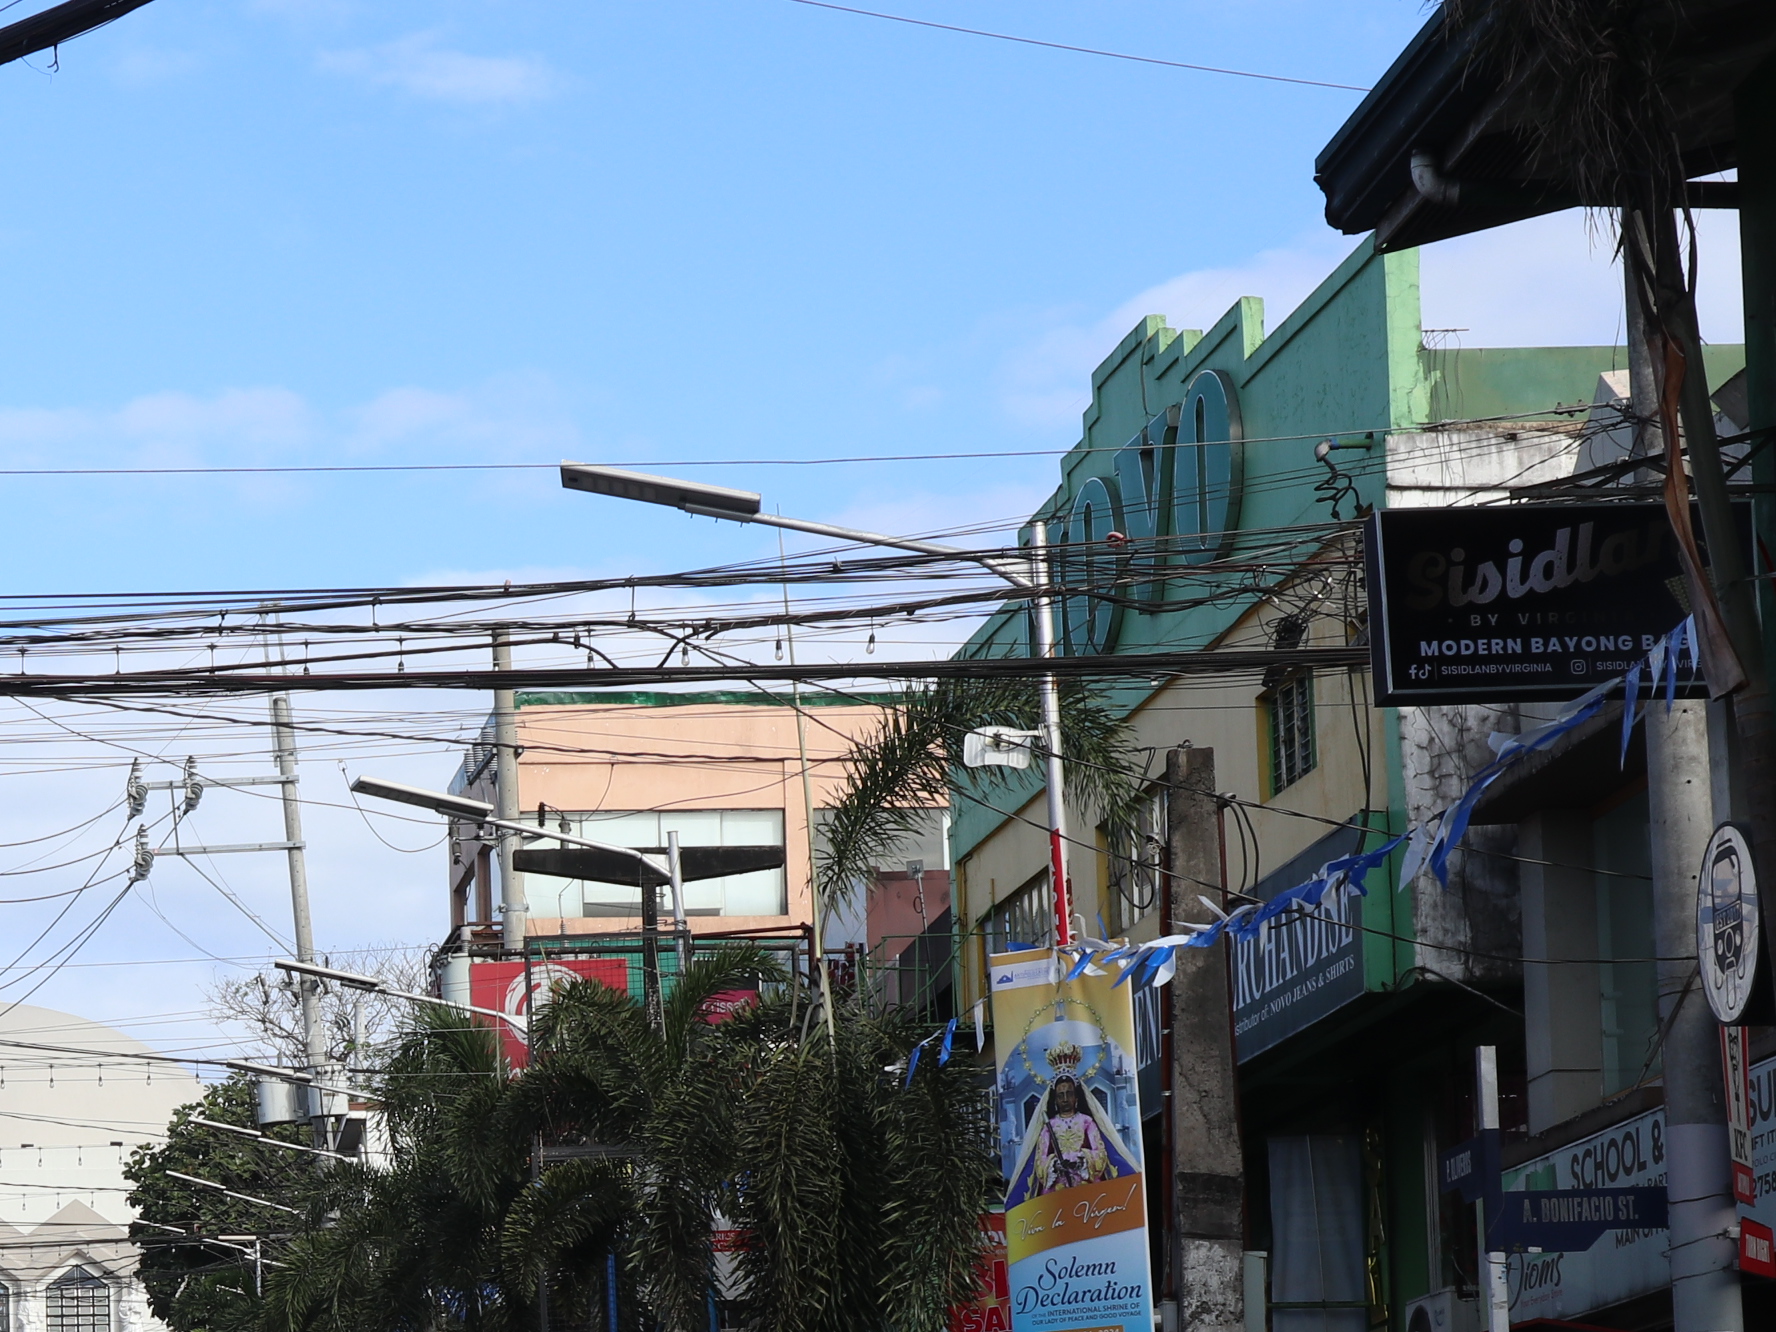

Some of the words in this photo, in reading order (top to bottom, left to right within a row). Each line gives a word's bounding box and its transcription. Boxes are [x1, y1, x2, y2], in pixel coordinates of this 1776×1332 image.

[1471, 614, 1499, 626] BY
[1420, 637, 1523, 657] MODERN
[1530, 635, 1633, 653] BAYONG
[1441, 662, 1553, 675] SISIDLANBYVIRGINIA
[1270, 996, 1291, 1018] NOVO
[1292, 982, 1316, 1004] JEANS
[1325, 954, 1354, 982] SHIRTS
[1571, 1127, 1647, 1190] SCHOOL
[1652, 1119, 1664, 1165] &
[1734, 1127, 1749, 1163] KFC
[1014, 1211, 1045, 1239] Viva
[1052, 1208, 1065, 1228] la
[1073, 1183, 1137, 1229] Virgen!
[1523, 1199, 1537, 1224] A.
[1541, 1196, 1614, 1222] BONIFACIO
[1618, 1196, 1639, 1220] ST.
[1038, 1256, 1116, 1290] Solemn
[1016, 1280, 1142, 1315] Declaration
[1048, 1306, 1101, 1317] INTERNATIONAL
[1103, 1303, 1128, 1312] SHRINE
[1130, 1302, 1140, 1310] OF
